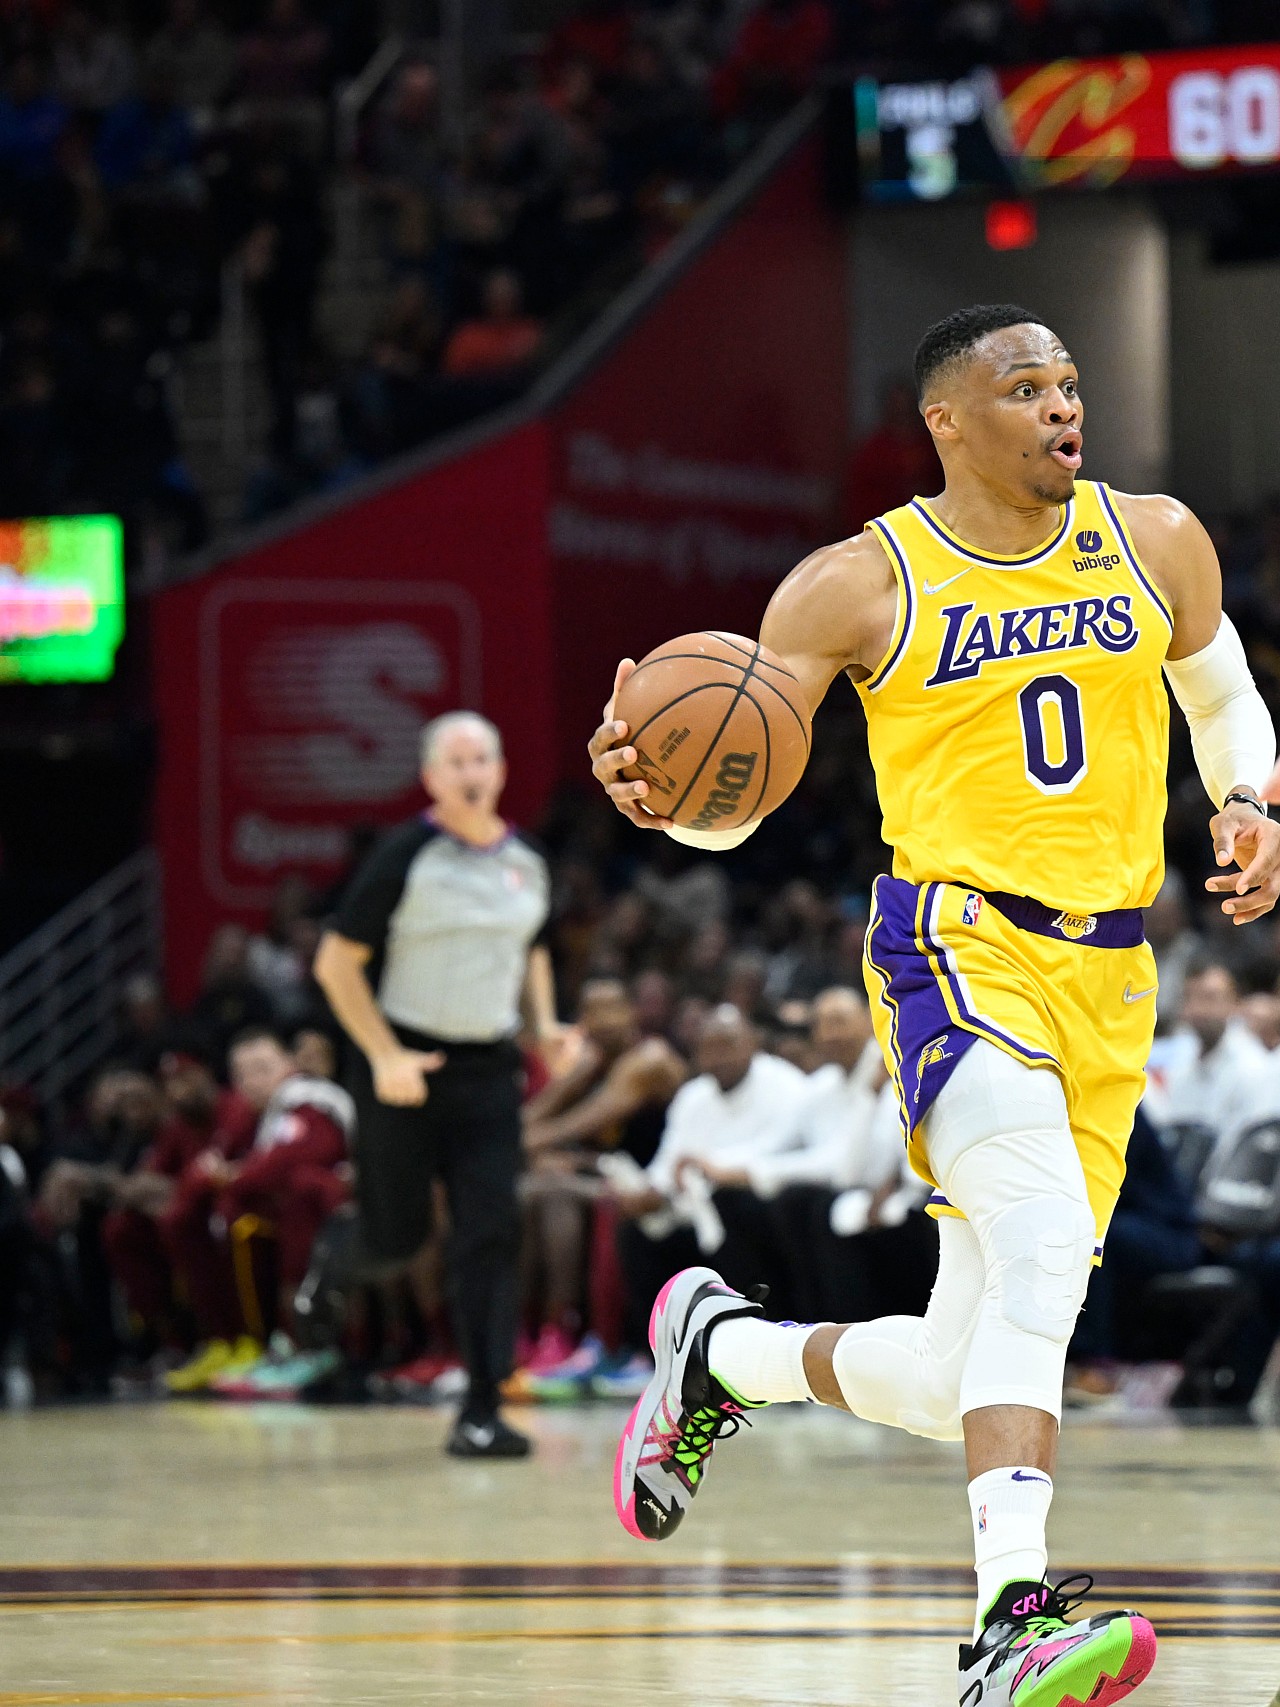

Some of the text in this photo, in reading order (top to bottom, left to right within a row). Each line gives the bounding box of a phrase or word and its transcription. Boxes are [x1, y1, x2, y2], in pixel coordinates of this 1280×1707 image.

[1072, 554, 1121, 572] bibigo
[923, 594, 1140, 690] LAKERS
[1016, 672, 1088, 796] 0
[1052, 911, 1096, 934] LAKERS
